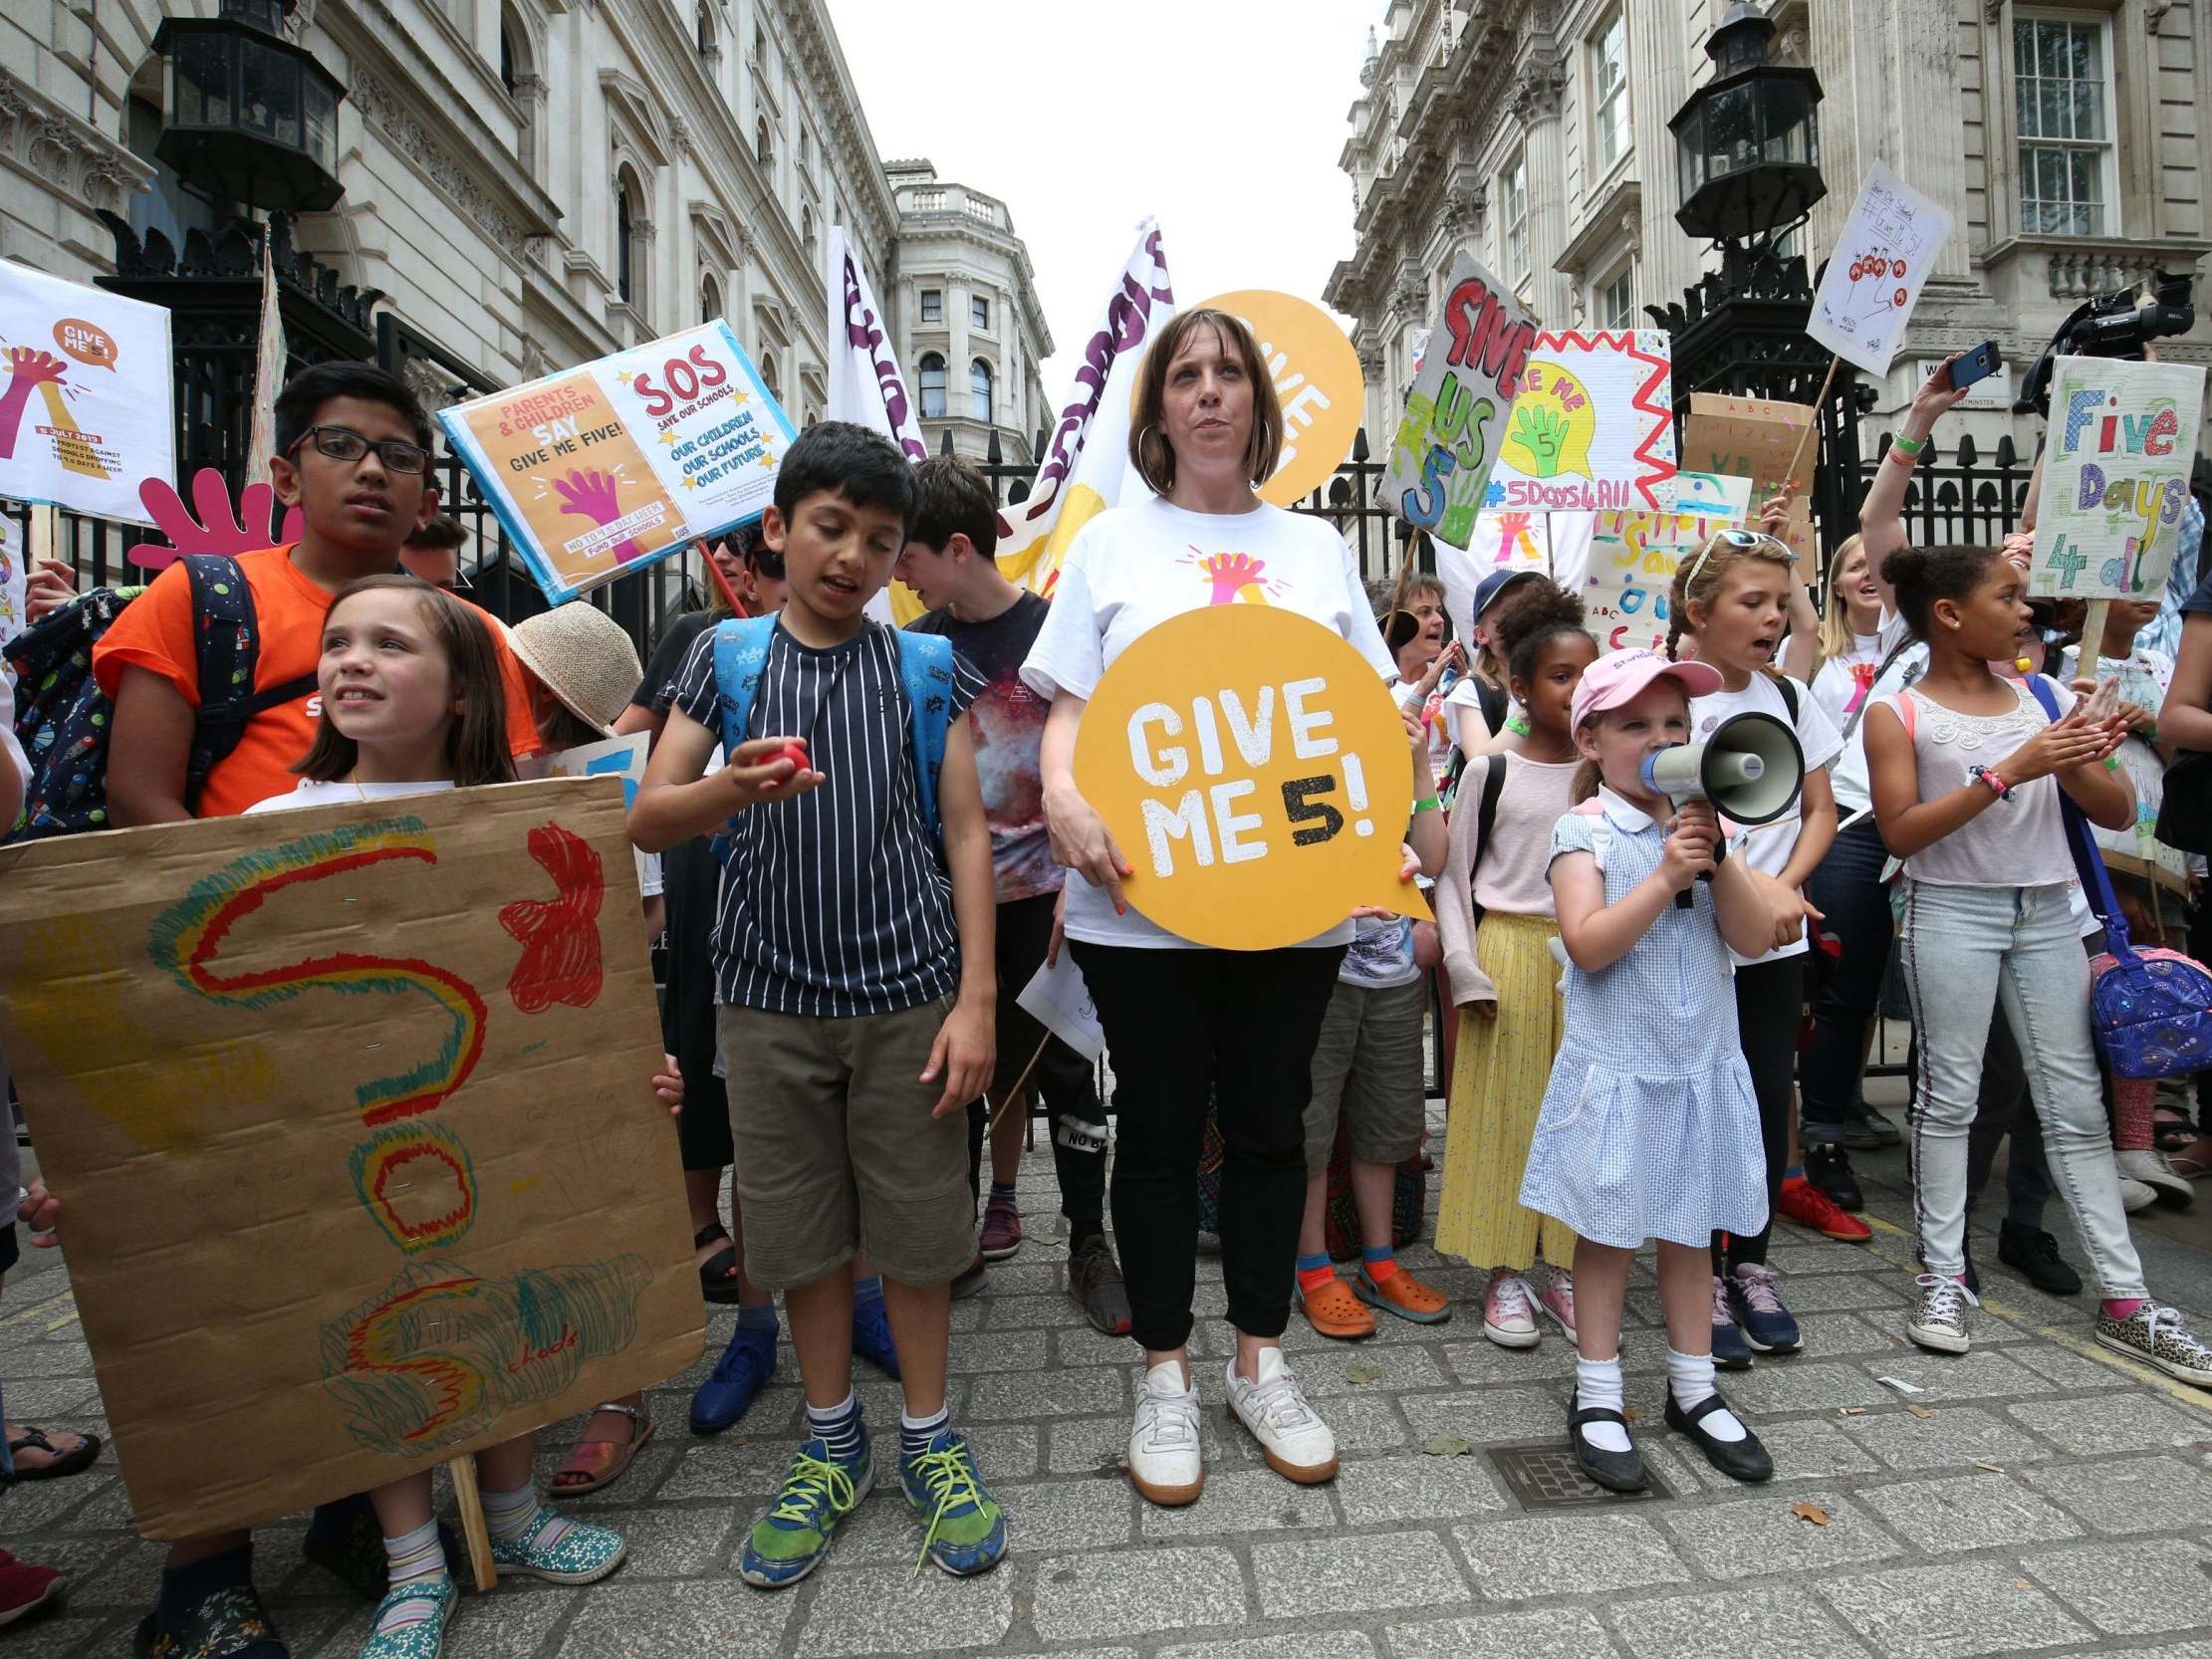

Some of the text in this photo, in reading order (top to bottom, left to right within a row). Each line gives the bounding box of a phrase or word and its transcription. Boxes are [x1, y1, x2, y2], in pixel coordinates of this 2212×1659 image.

[65, 326, 105, 348] GIVE
[65, 337, 109, 359] ME 5!
[500, 385, 577, 419] PARENTS
[633, 344, 727, 418] SOS
[1550, 376, 1586, 413] ME
[498, 394, 597, 437] & CHILDREN
[657, 383, 735, 431] SAVE OUR SCHOOLS
[1432, 370, 1495, 471] US
[2064, 389, 2179, 457] Five
[50, 429, 73, 438] JULY
[57, 440, 89, 451] PROTEST
[90, 448, 122, 458] AGAINST
[509, 422, 623, 472] GIVE ME FIVE!
[531, 414, 580, 447] SAY
[670, 410, 754, 461] OUR CHILDREN
[682, 426, 761, 475] OUR SCHOOLS
[1538, 432, 1556, 458] 5
[52, 446, 122, 467] SCHOOLS DROPPING
[696, 443, 766, 488] OUR FUTURE
[1401, 444, 1458, 529] 5
[567, 539, 584, 552] NO
[584, 532, 598, 545] TO
[614, 517, 634, 532] DAY
[633, 503, 663, 520] WEEK
[675, 525, 690, 539] SOS
[2078, 463, 2187, 556] Days
[588, 516, 663, 557] FUND OUR SCHOOLS
[2046, 533, 2145, 592] 4 all
[1126, 677, 1340, 788] GIVE
[1139, 753, 1374, 878] ME 5!
[1068, 1132, 1087, 1146] NO
